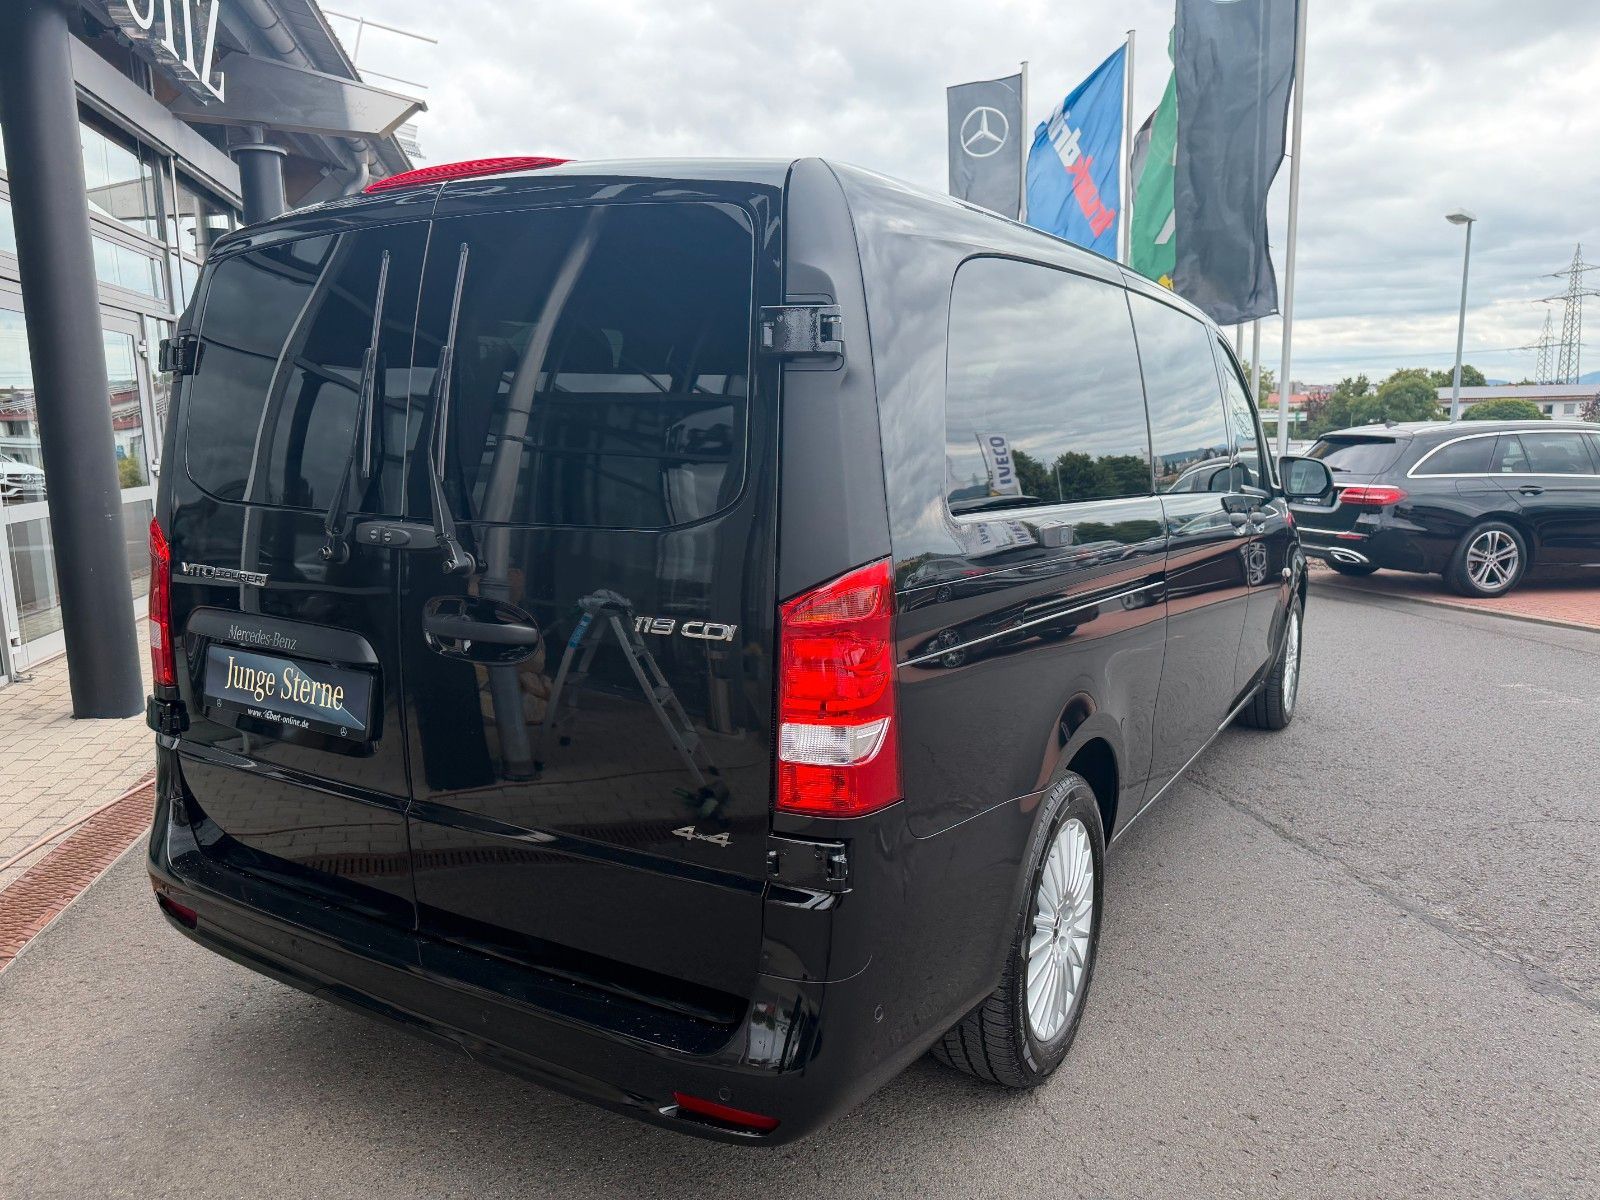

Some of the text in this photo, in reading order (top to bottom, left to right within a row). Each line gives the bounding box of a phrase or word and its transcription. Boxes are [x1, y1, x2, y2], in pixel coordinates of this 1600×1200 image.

[989, 436, 1012, 485] IVECO
[228, 624, 297, 650] Mercedes-Benz
[635, 616, 738, 642] 119 CDI
[224, 655, 344, 711] Junge Sterne
[671, 825, 734, 848] 4x4
